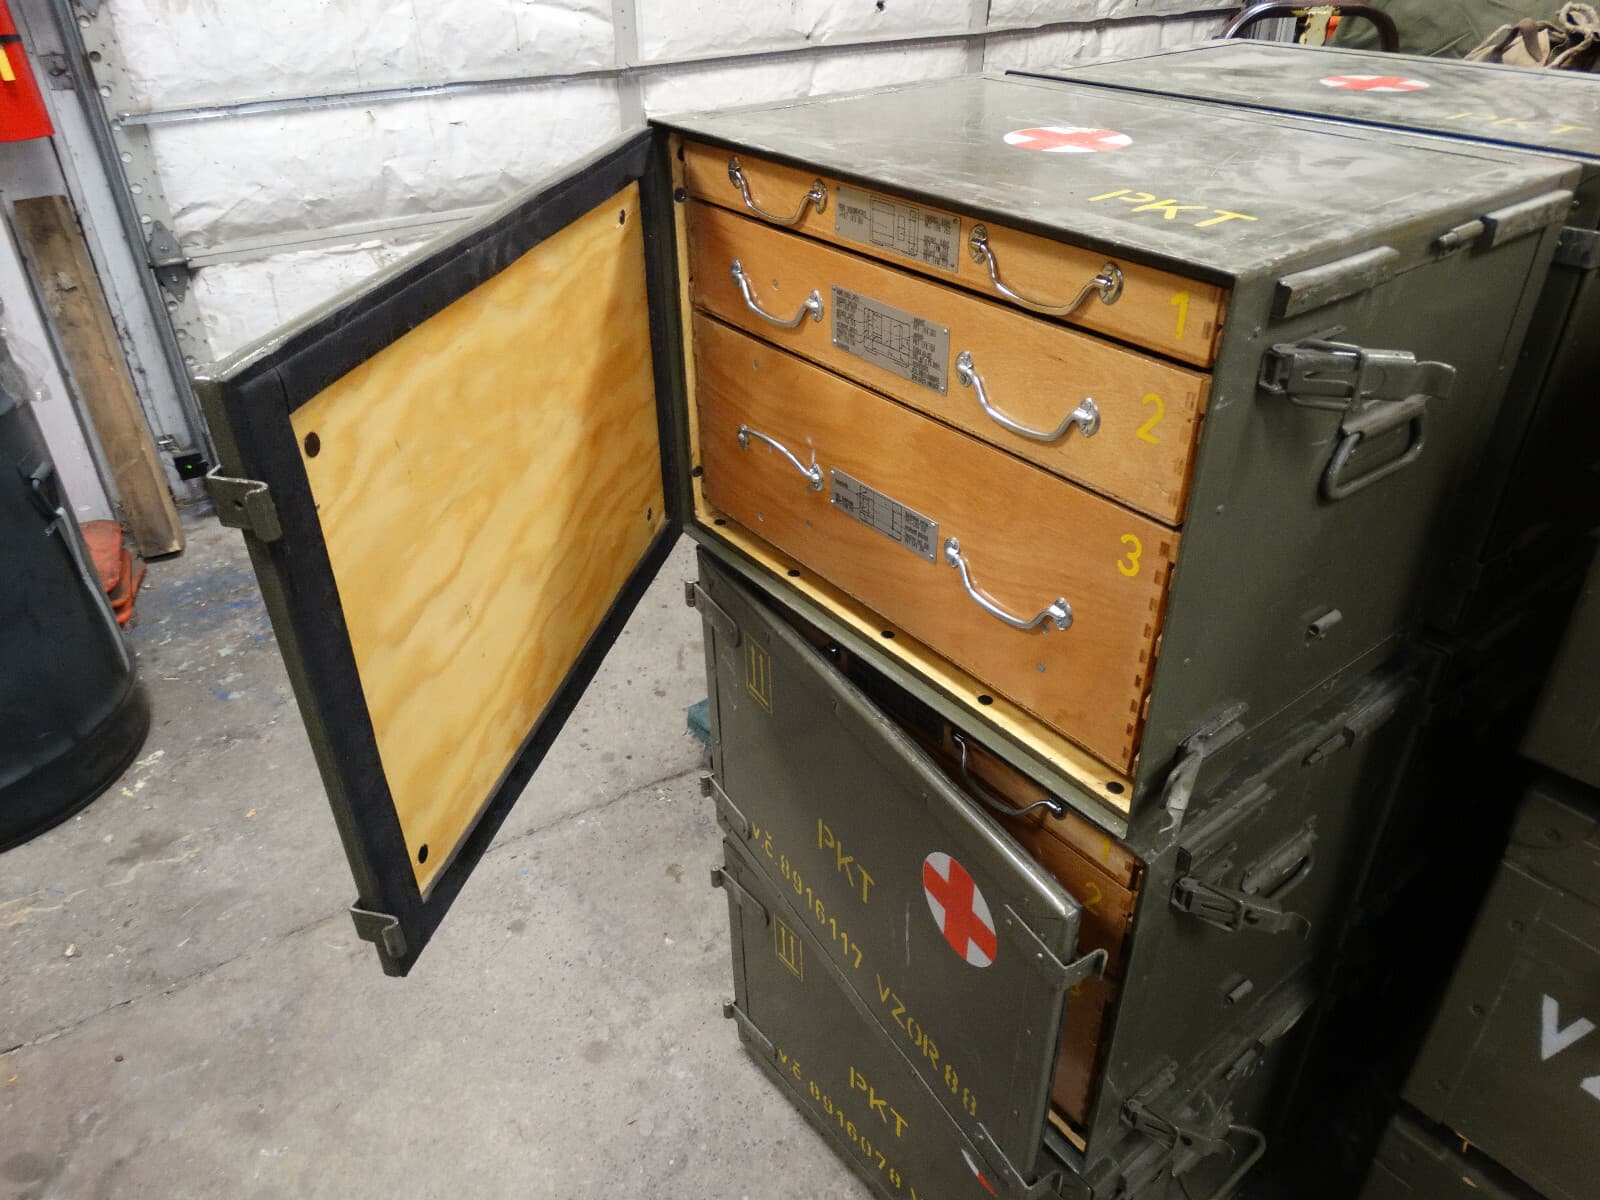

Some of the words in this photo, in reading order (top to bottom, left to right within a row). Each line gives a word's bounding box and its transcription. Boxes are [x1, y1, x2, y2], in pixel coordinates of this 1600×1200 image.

[1445, 112, 1593, 134] PKT
[1088, 189, 1258, 227] PKT
[1170, 290, 1190, 340] 1
[1136, 392, 1165, 445] 2
[1117, 534, 1142, 577] 3
[817, 818, 875, 904] PKT
[1083, 882, 1103, 916] 2
[875, 973, 940, 1071] VZOR
[849, 1066, 909, 1137] PKT
